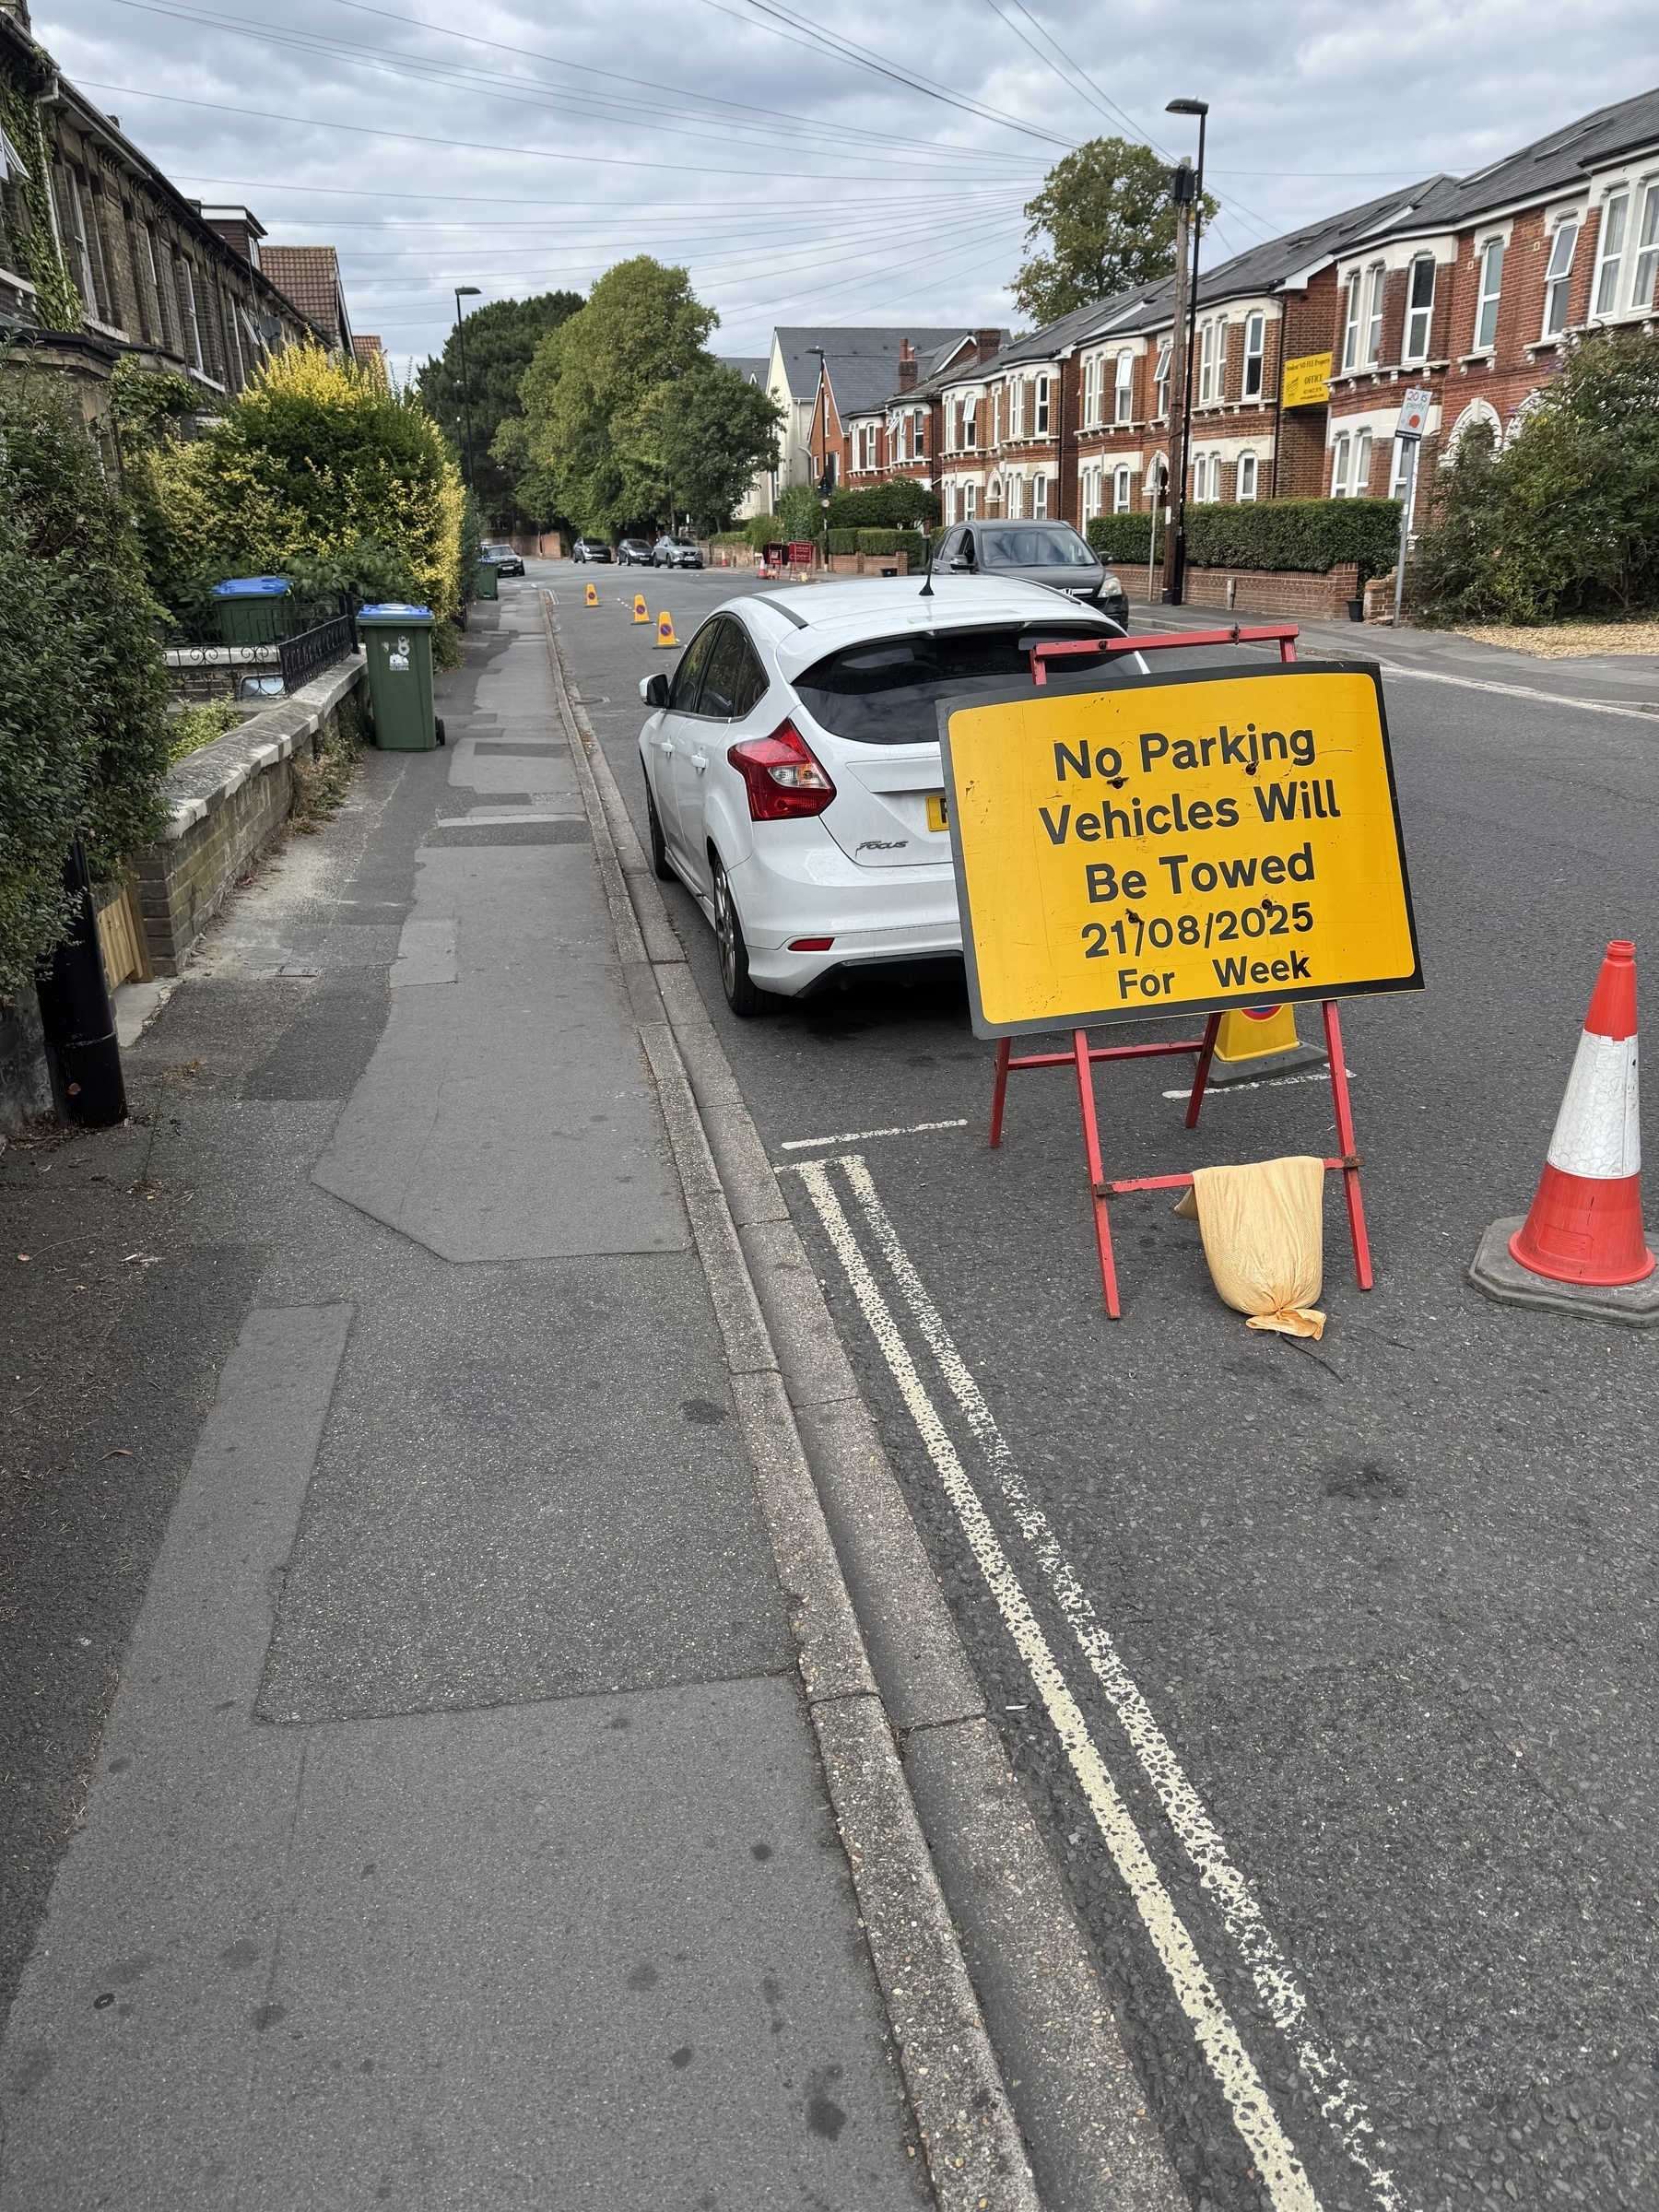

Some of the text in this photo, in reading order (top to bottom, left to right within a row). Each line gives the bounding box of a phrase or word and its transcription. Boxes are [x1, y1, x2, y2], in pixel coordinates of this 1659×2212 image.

[1304, 373, 1324, 384] OFFICE
[1406, 391, 1429, 403] 20 is
[1406, 402, 1426, 411] plenty
[1054, 724, 1315, 782] No Parking
[1038, 779, 1341, 845] Vehicles Will
[1086, 841, 1315, 903] Be Towed
[1081, 902, 1313, 959] 21/08/2025
[1118, 950, 1312, 999] For Week
